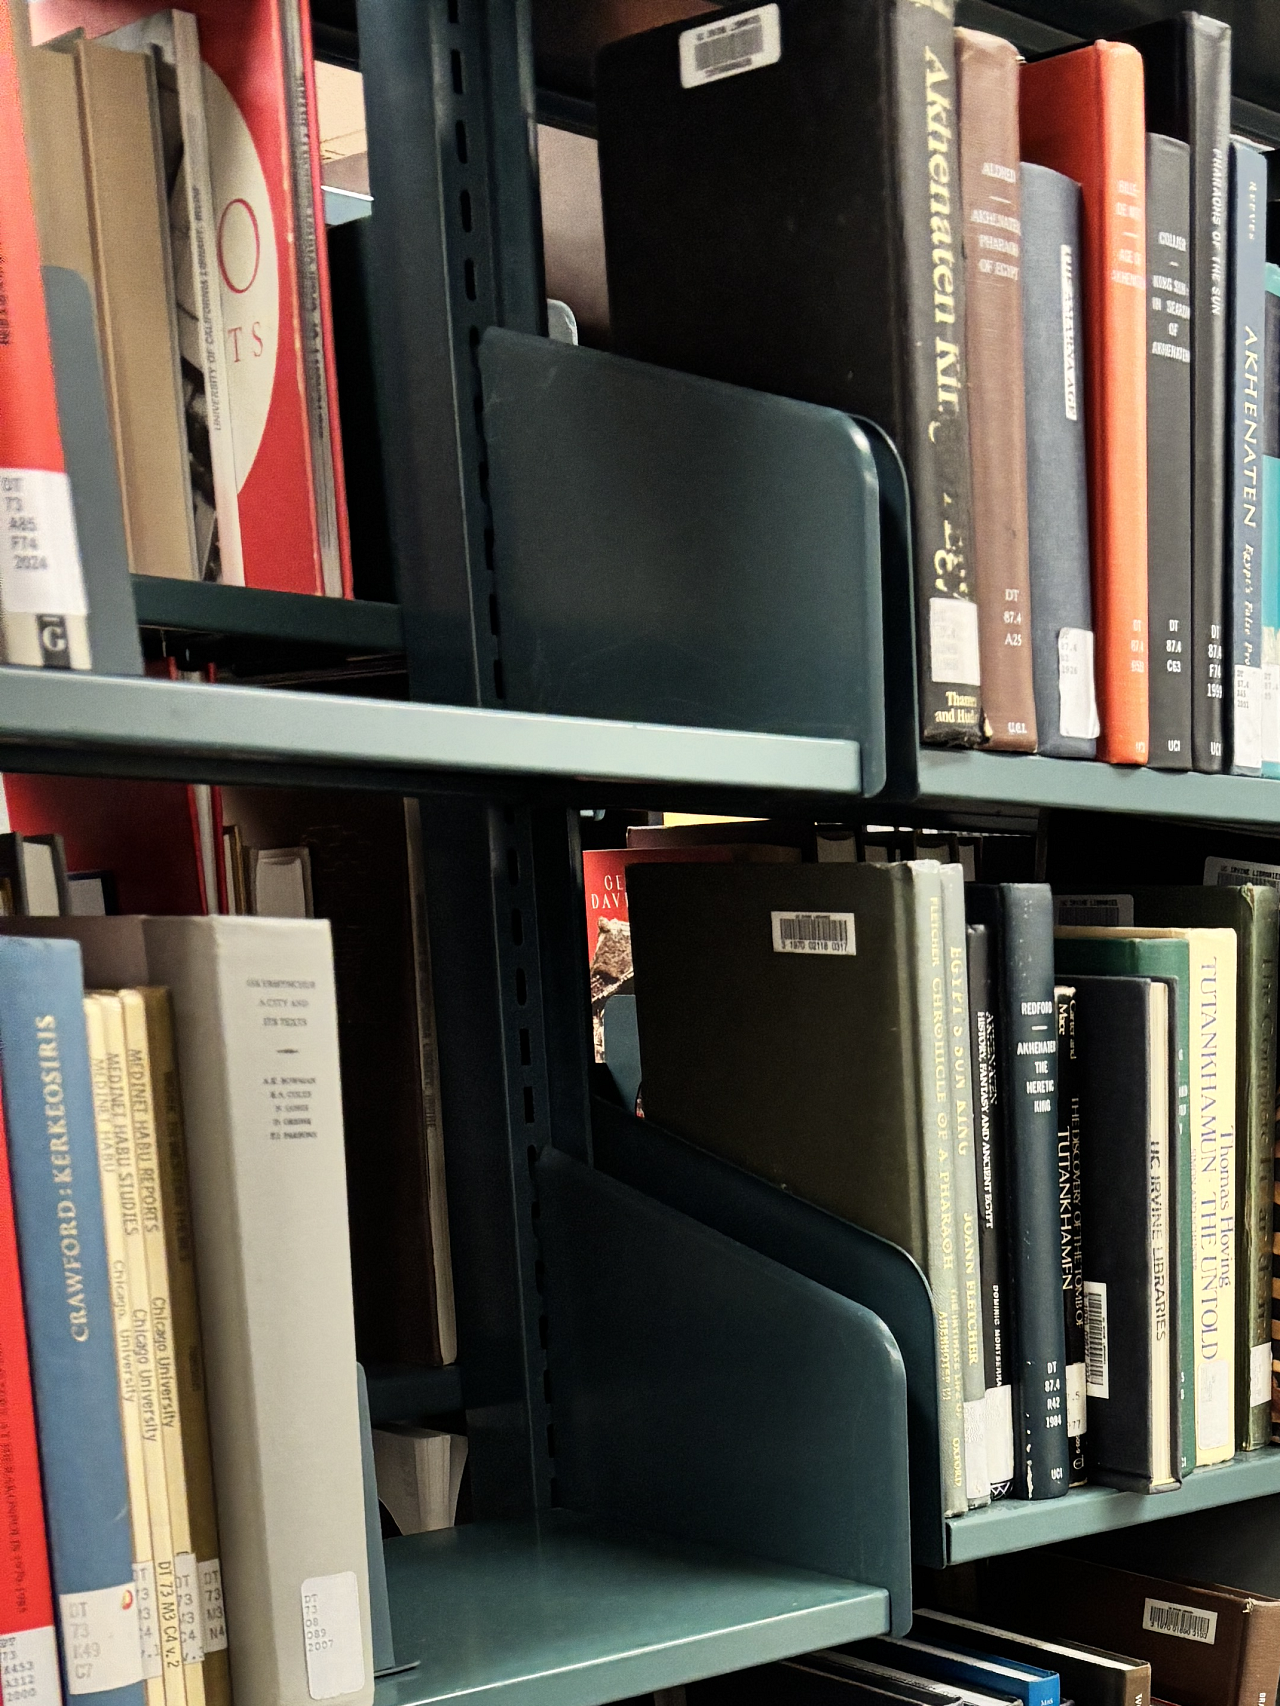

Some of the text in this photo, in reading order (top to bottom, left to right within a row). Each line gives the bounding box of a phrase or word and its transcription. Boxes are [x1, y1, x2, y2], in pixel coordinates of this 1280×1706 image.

[925, 46, 954, 323] Akhenaten
[1211, 286, 1221, 316] SUN
[1243, 326, 1258, 528] AKHENATEN
[1004, 611, 1022, 625] 87.4
[1005, 589, 1020, 602] DT
[38, 1014, 74, 1184] KERKEOSIRIS
[1034, 1061, 1049, 1074] THE
[106, 1053, 139, 1237] MEDINET HABU STUDIES
[129, 1048, 160, 1233] MEDINET HABU REPORTS
[1200, 956, 1219, 1361] TUTANKHAMUN THE UNTOLD
[1219, 1126, 1235, 1288] Thomas Hoving
[1057, 1126, 1074, 1290] TUTANKHAMEN
[1151, 1176, 1167, 1342] IRVINE LIBRARIES
[118, 1329, 137, 1403] University
[133, 1309, 160, 1442] Chicago University
[152, 1297, 177, 1428] Chicago University
[1044, 1379, 1060, 1393] 87.4
[1046, 1362, 1058, 1375] DT
[157, 1561, 178, 1643] DT 73 M3 C4
